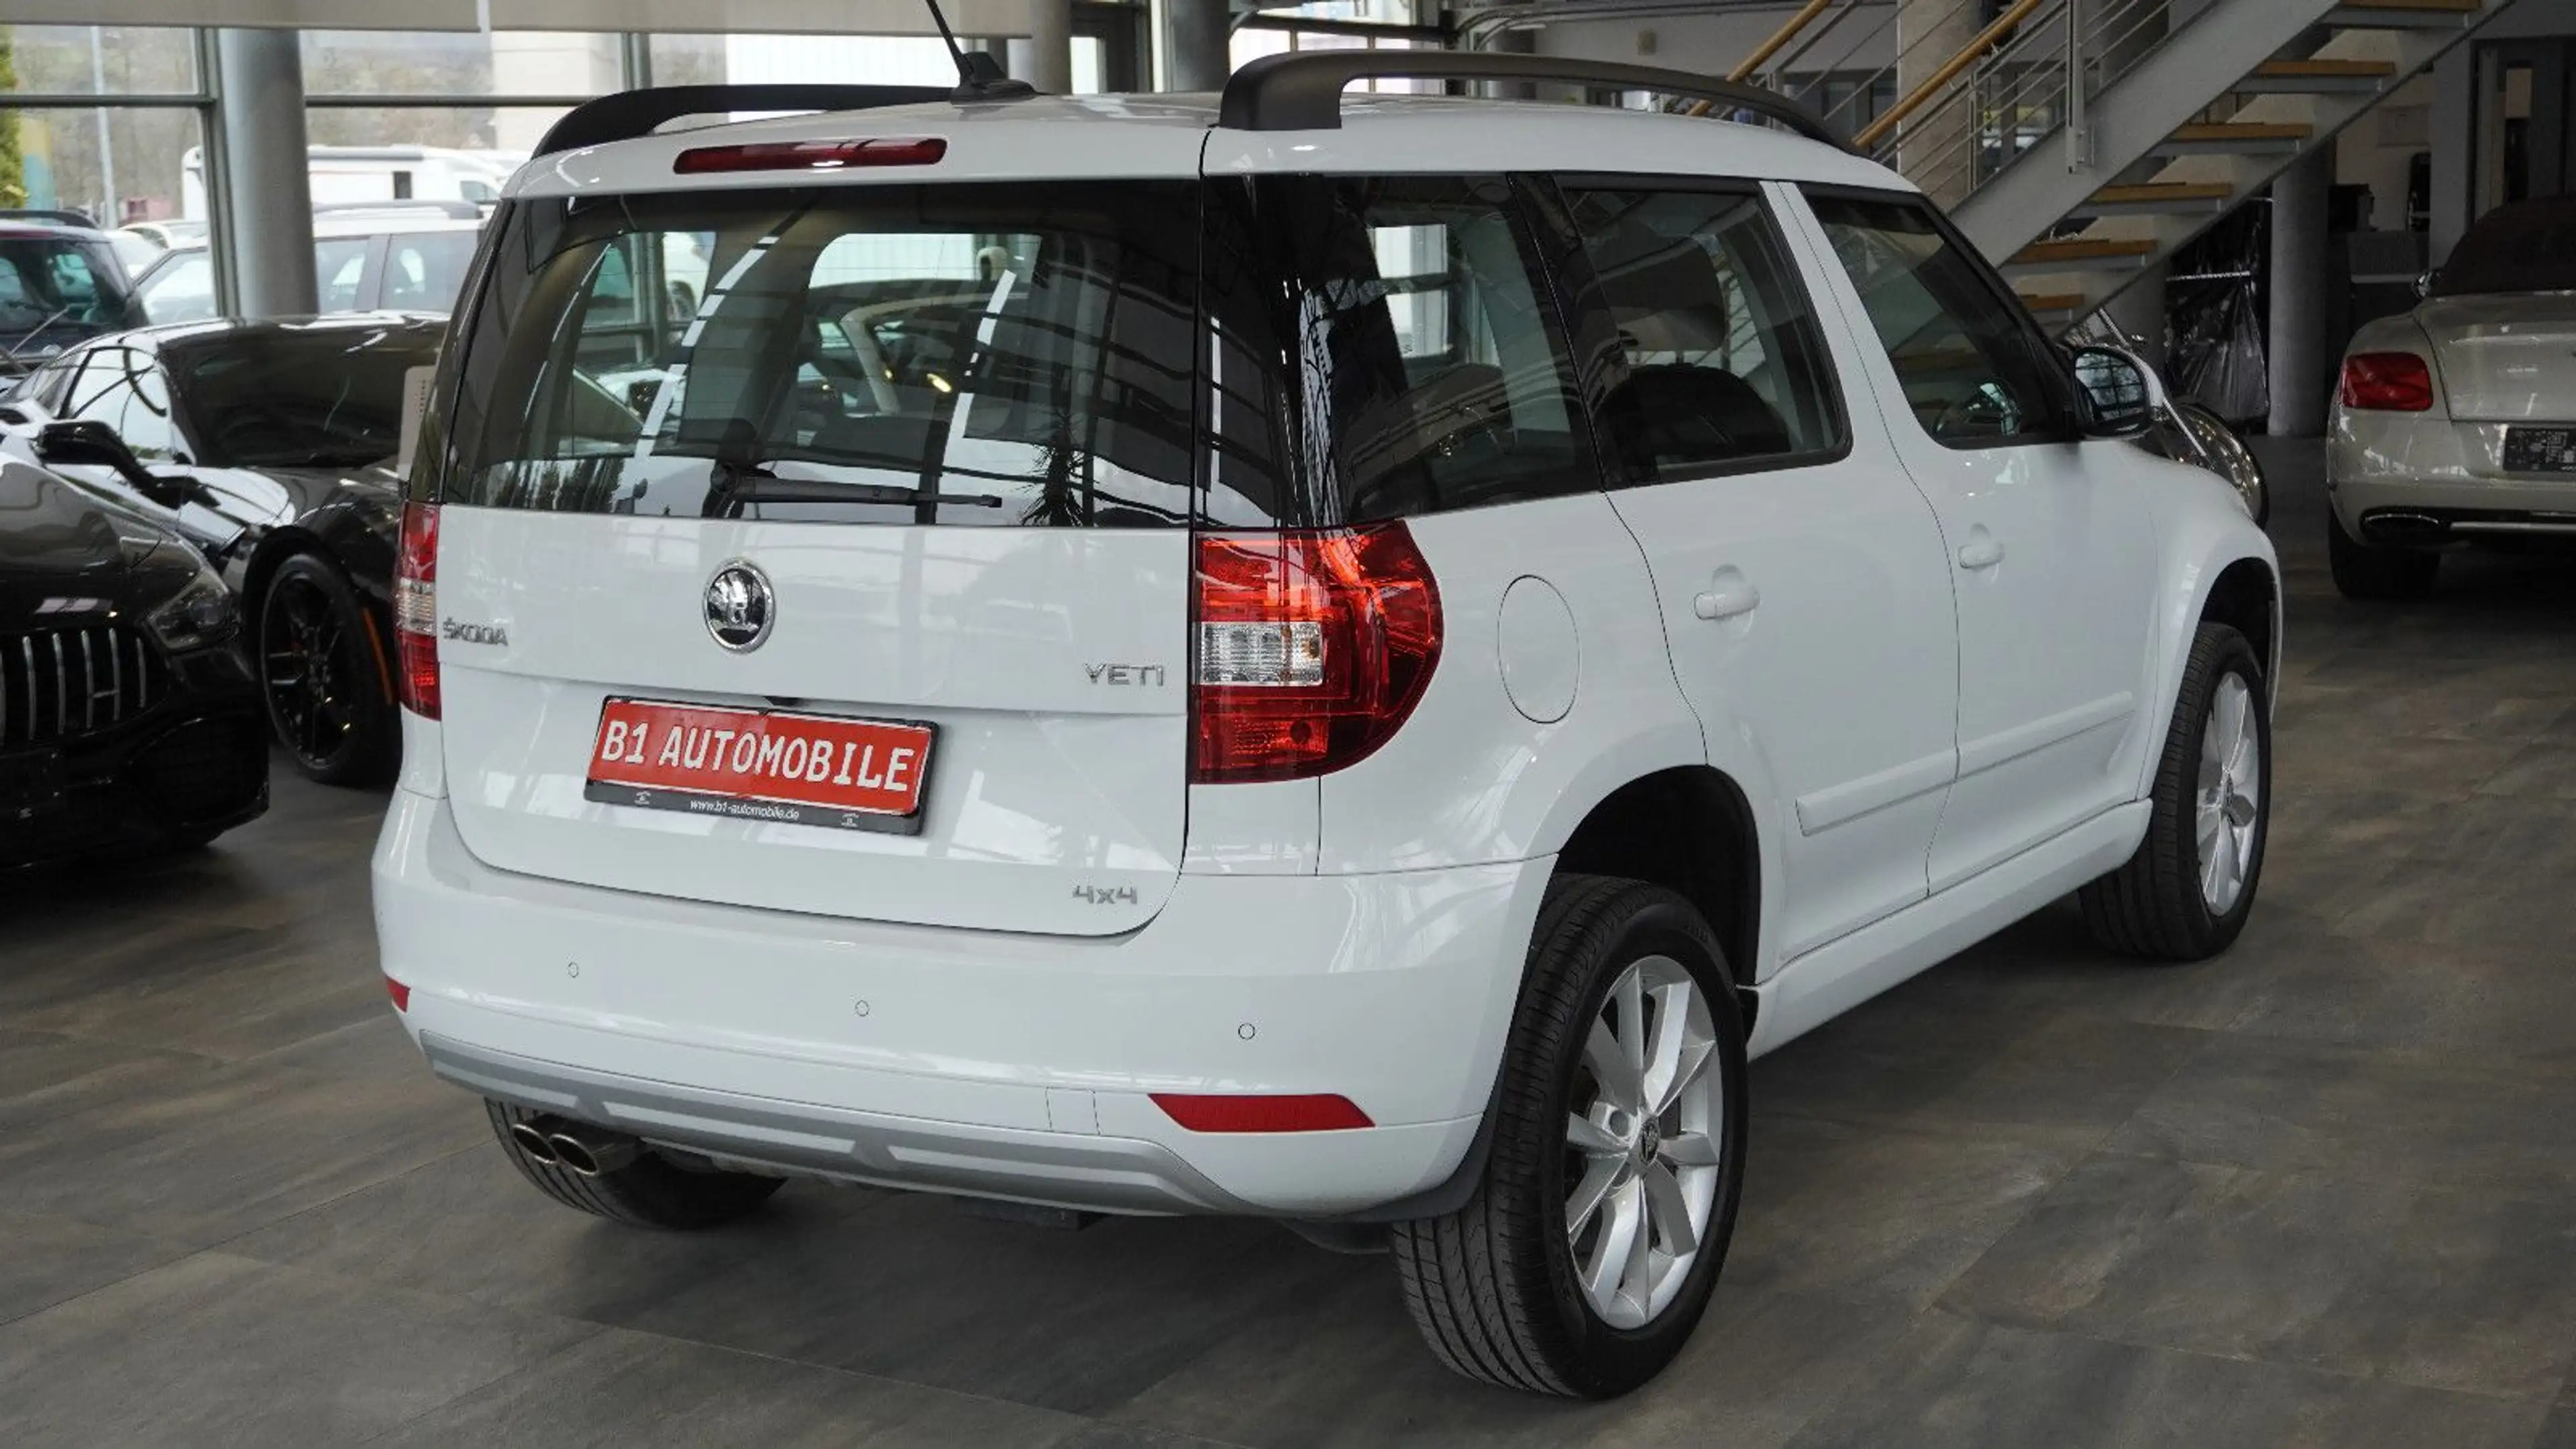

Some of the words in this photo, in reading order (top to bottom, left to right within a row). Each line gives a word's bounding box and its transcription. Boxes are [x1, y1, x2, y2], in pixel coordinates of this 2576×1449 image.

[1083, 661, 1164, 686] YETI
[601, 720, 649, 764] B1
[658, 725, 914, 792] AUTOMOBILE
[690, 799, 800, 821] www.b1-automobile.de
[1072, 884, 1138, 905] 4x4
